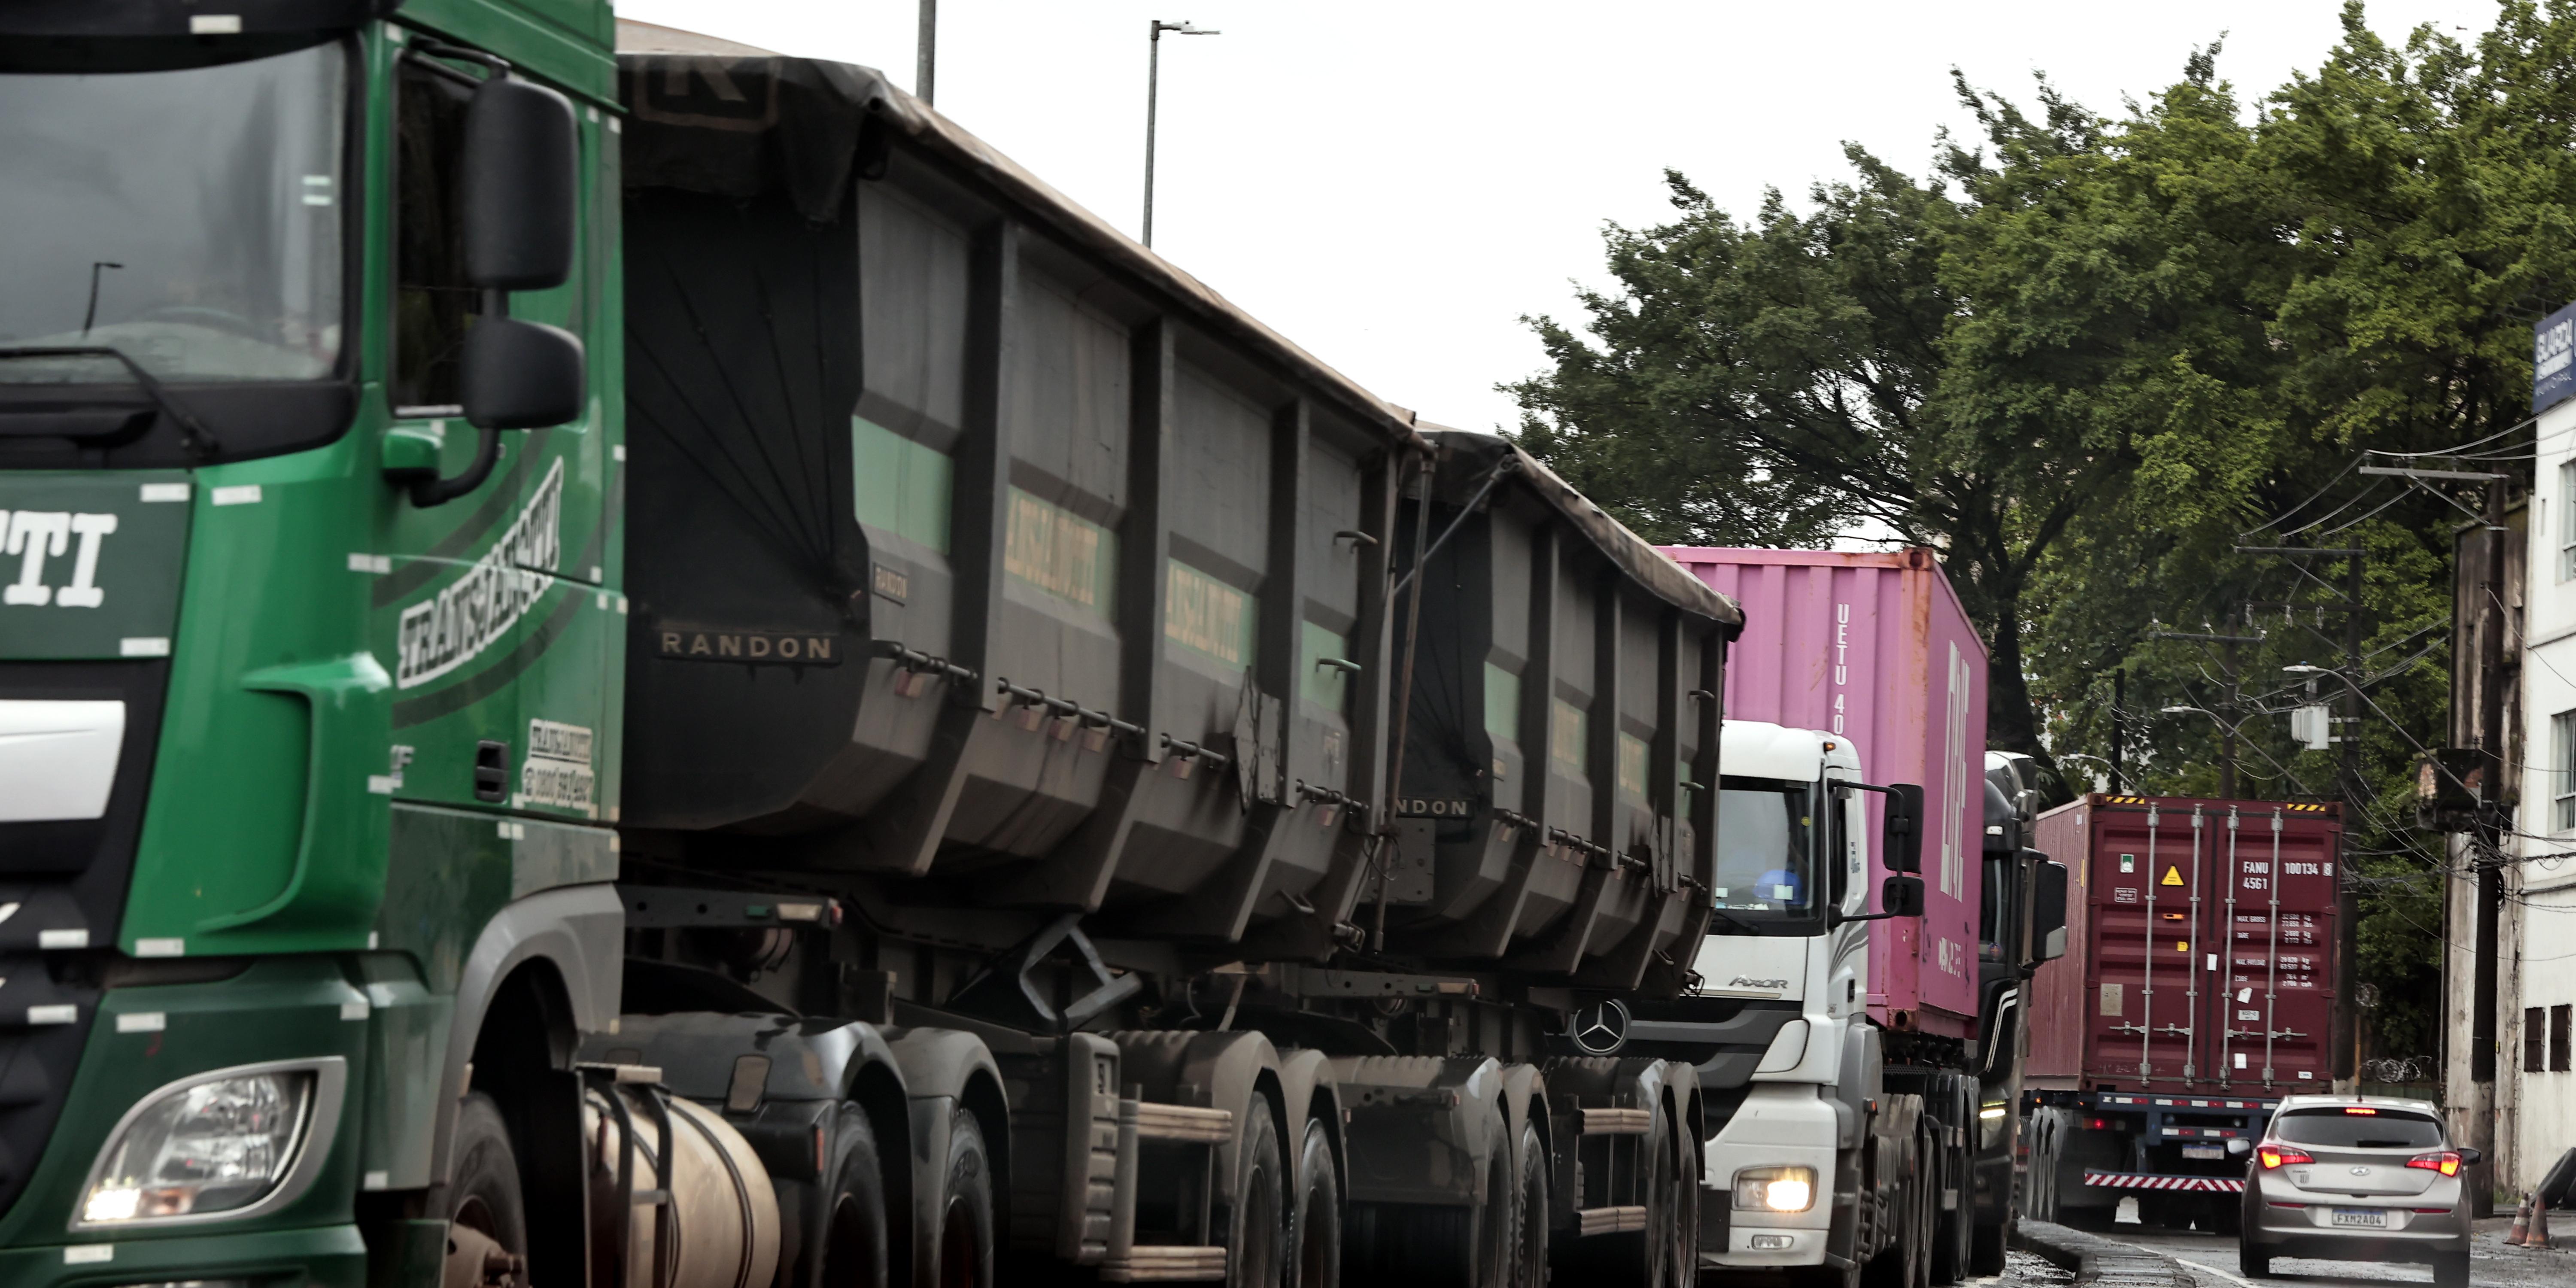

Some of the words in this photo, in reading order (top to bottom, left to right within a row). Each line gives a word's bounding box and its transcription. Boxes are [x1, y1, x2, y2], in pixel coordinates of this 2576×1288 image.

[0, 510, 117, 608] TI
[662, 632, 831, 659] RANDON
[2243, 861, 2269, 874] FANU
[2284, 862, 2318, 875] 100134
[1729, 974, 1788, 989] AXOR
[2337, 1214, 2381, 1225] FXM2A04
